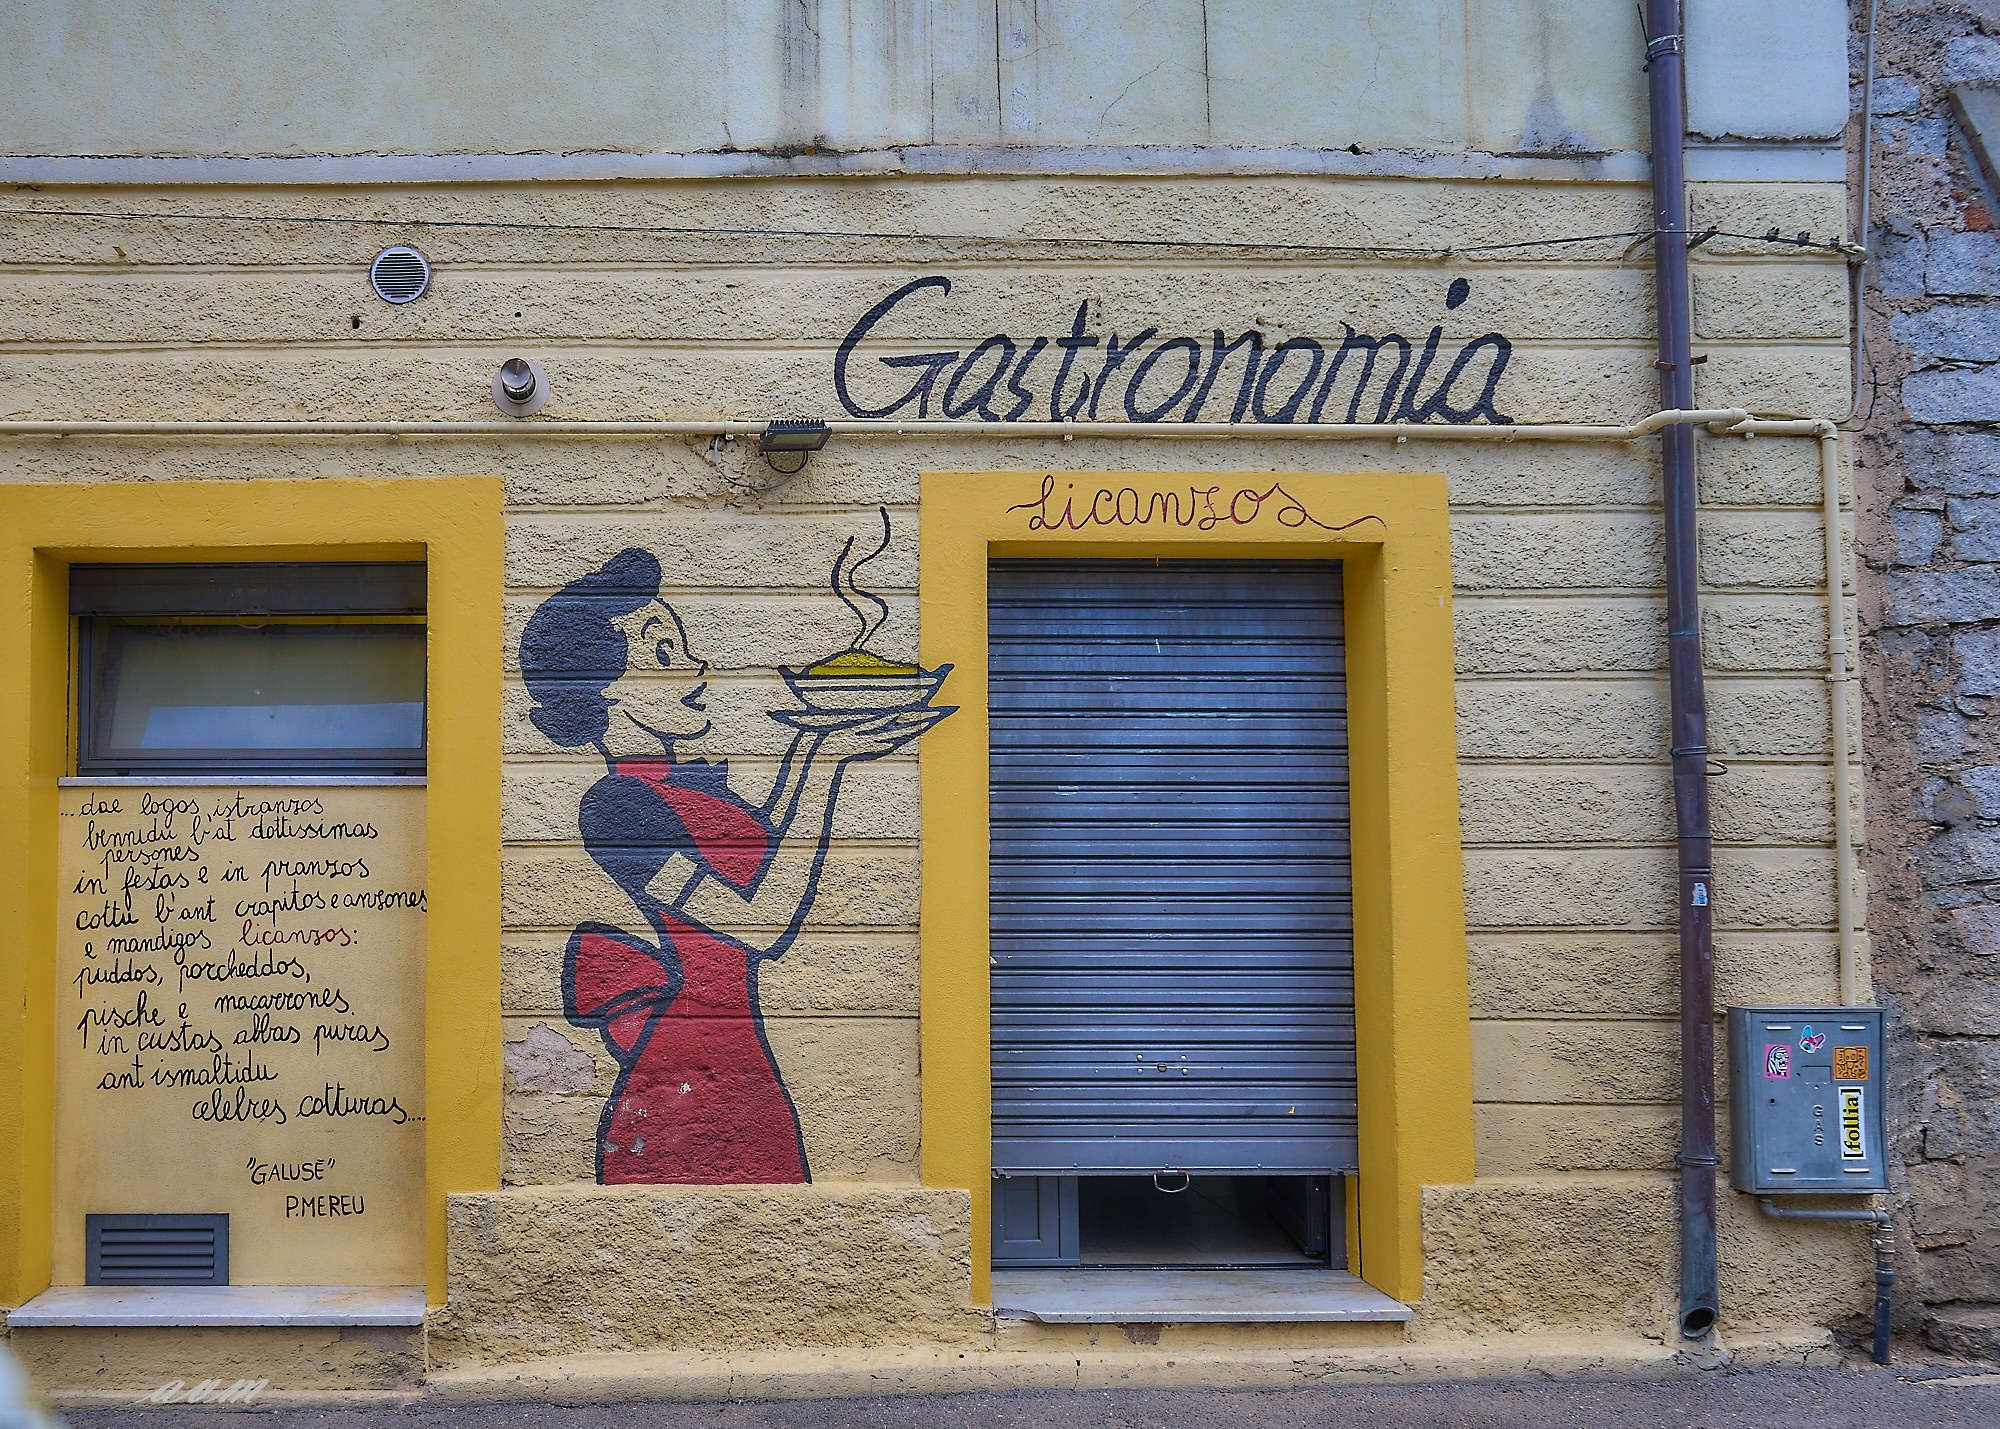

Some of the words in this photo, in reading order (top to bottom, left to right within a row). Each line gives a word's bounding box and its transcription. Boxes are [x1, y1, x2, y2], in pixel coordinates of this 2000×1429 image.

[834, 275, 1513, 424] Gastronomia
[1006, 474, 1388, 531] Licanzos
[212, 790, 324, 818] istranzos
[82, 819, 178, 851] bennidu
[73, 869, 108, 895] in
[121, 862, 190, 911] festas
[197, 865, 209, 885] e
[220, 860, 249, 882] in
[260, 858, 370, 893] pranzos
[99, 845, 201, 881] persones
[76, 899, 140, 931] cottu
[235, 879, 326, 928] crapitos
[330, 893, 339, 909] e
[84, 941, 98, 960] e
[107, 925, 212, 965] mandigos
[73, 957, 163, 1000] puddos,
[178, 948, 311, 995] porcheddos,
[76, 989, 166, 1050] pische
[178, 1002, 189, 1019] e
[97, 1029, 130, 1056] in
[138, 1020, 223, 1053] custas
[232, 1012, 301, 1045] abbas
[313, 1023, 390, 1057] puras
[96, 1053, 145, 1090] ant
[150, 1049, 279, 1088] ismaltidu
[1813, 1104, 1824, 1146] GAS
[286, 1195, 365, 1218] P.MEREU
